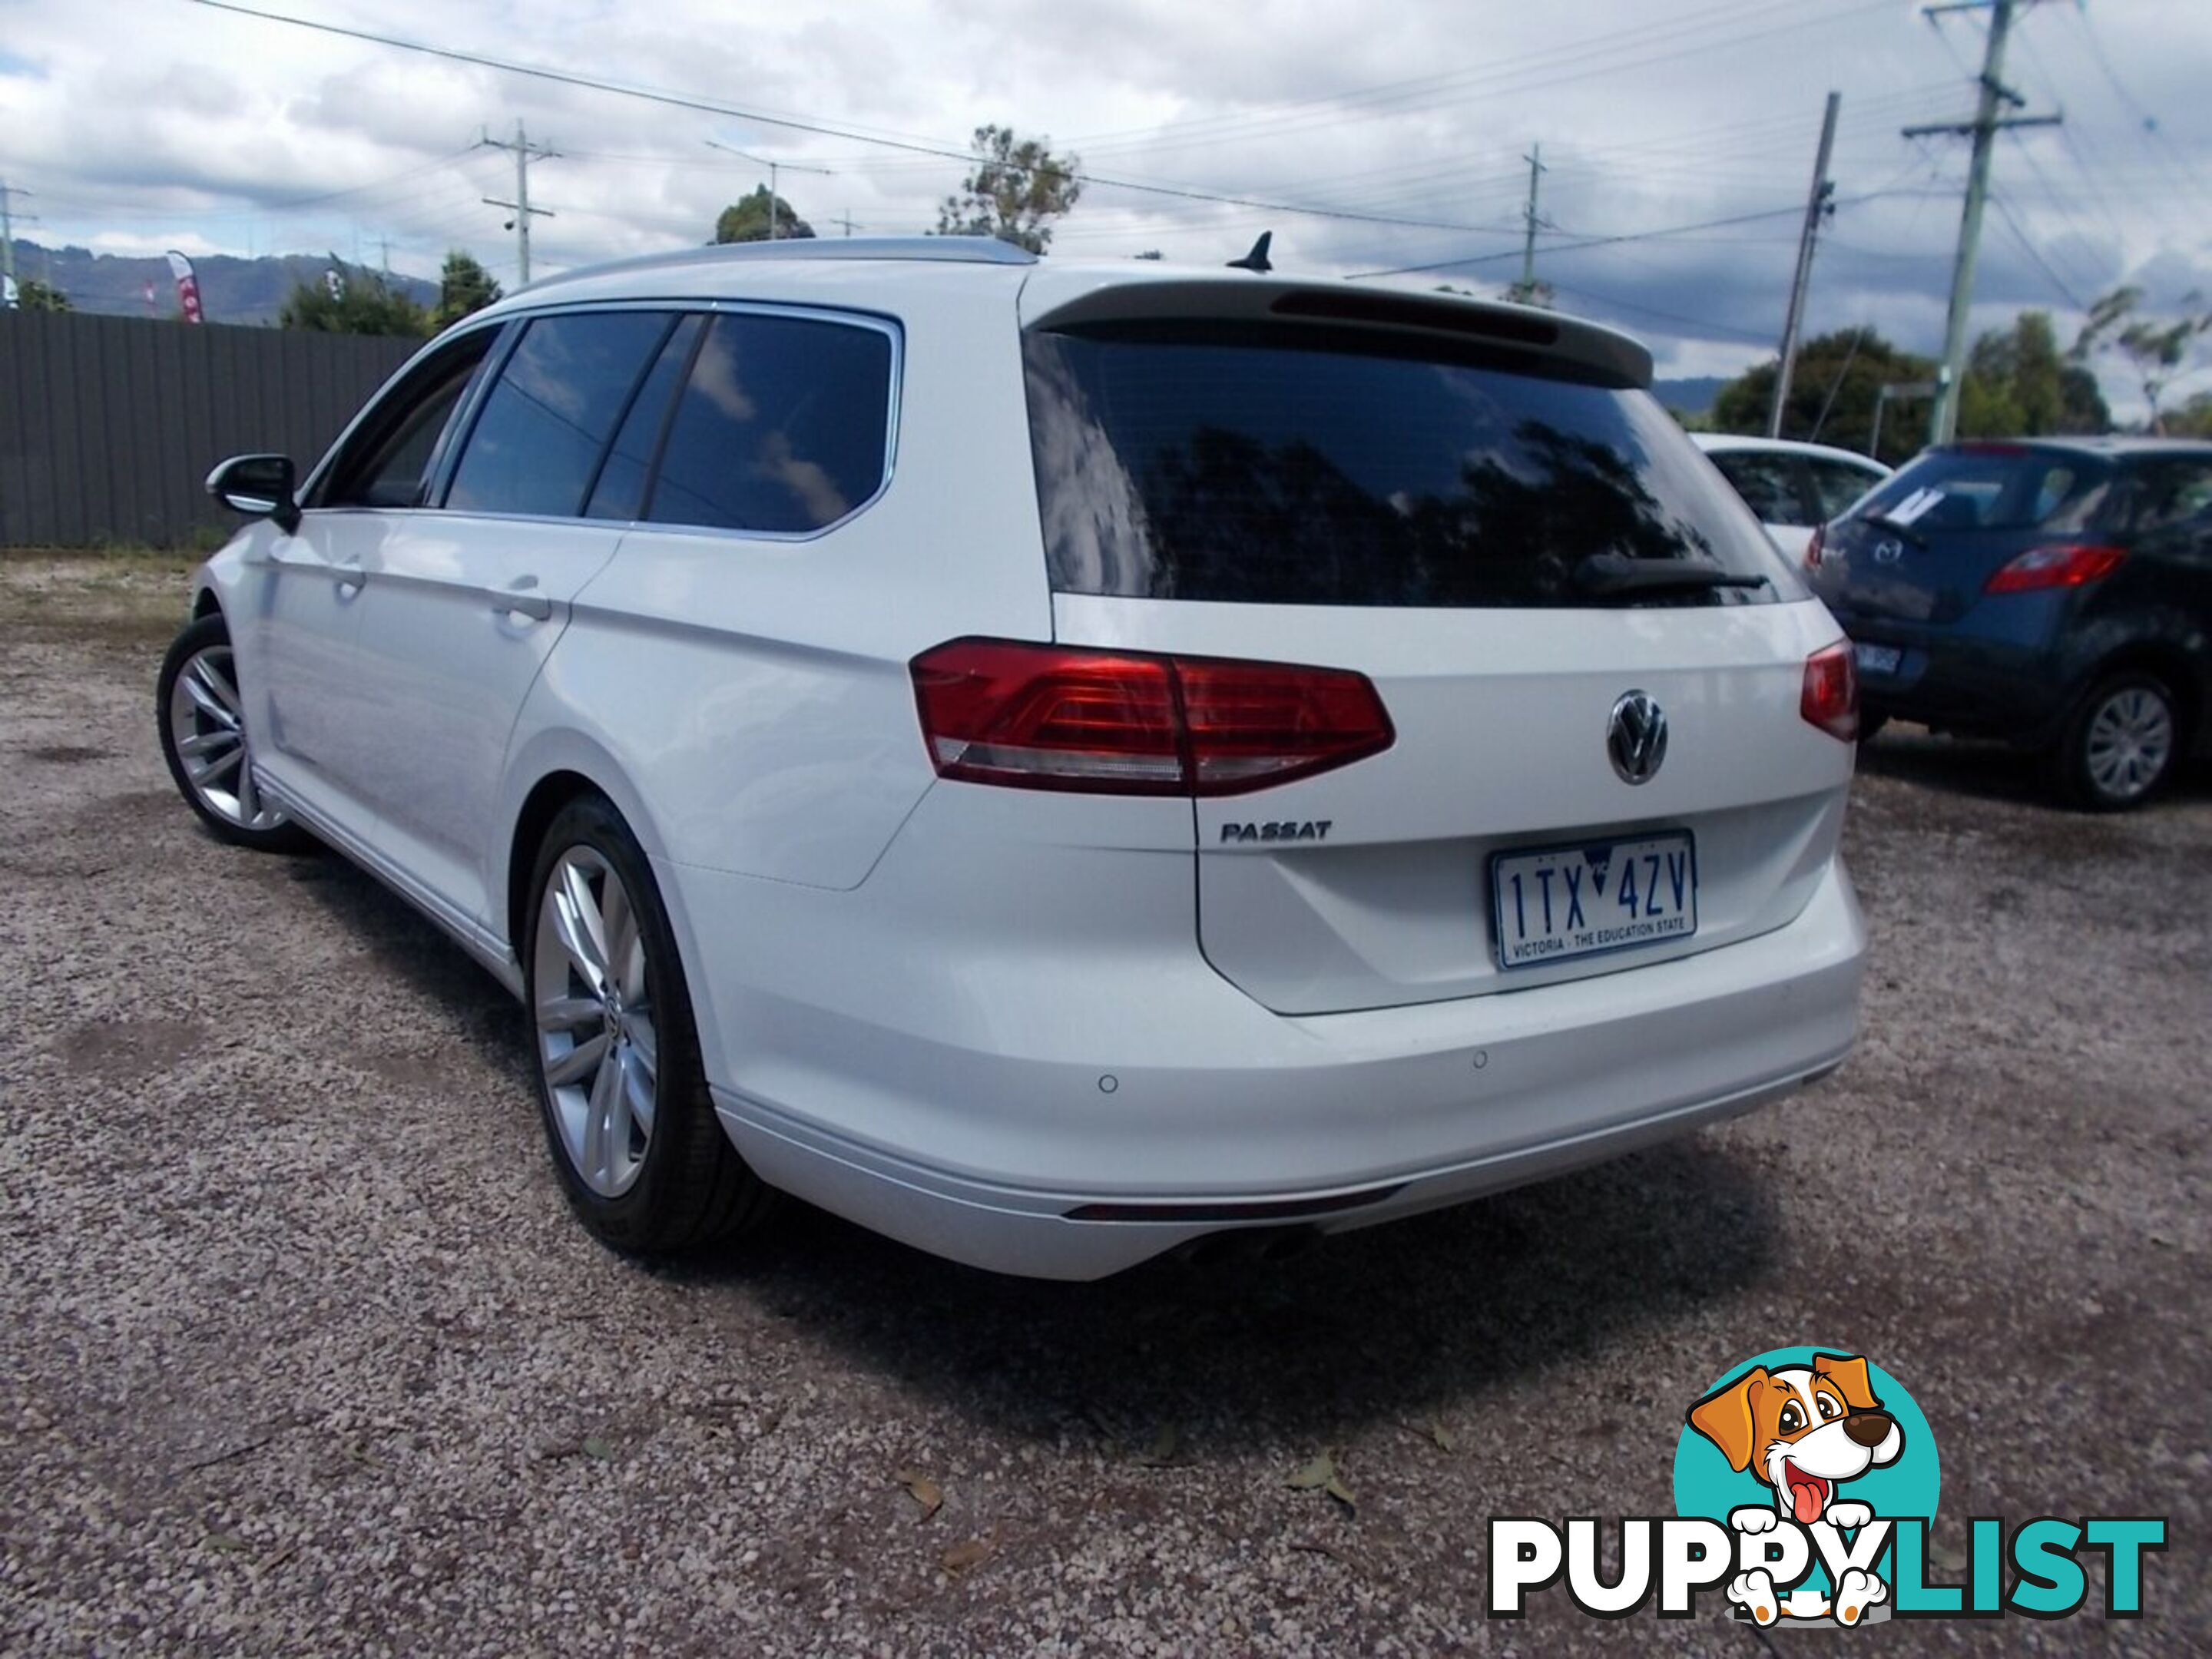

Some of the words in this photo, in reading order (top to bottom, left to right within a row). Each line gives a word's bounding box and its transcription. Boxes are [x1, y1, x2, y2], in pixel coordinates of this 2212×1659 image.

[1220, 820, 1333, 843] PASSAT
[1514, 939, 1564, 958] VICTORIA
[1575, 932, 1594, 947] THE
[1598, 922, 1654, 943] EDUCATION
[1657, 917, 1684, 933] STATE
